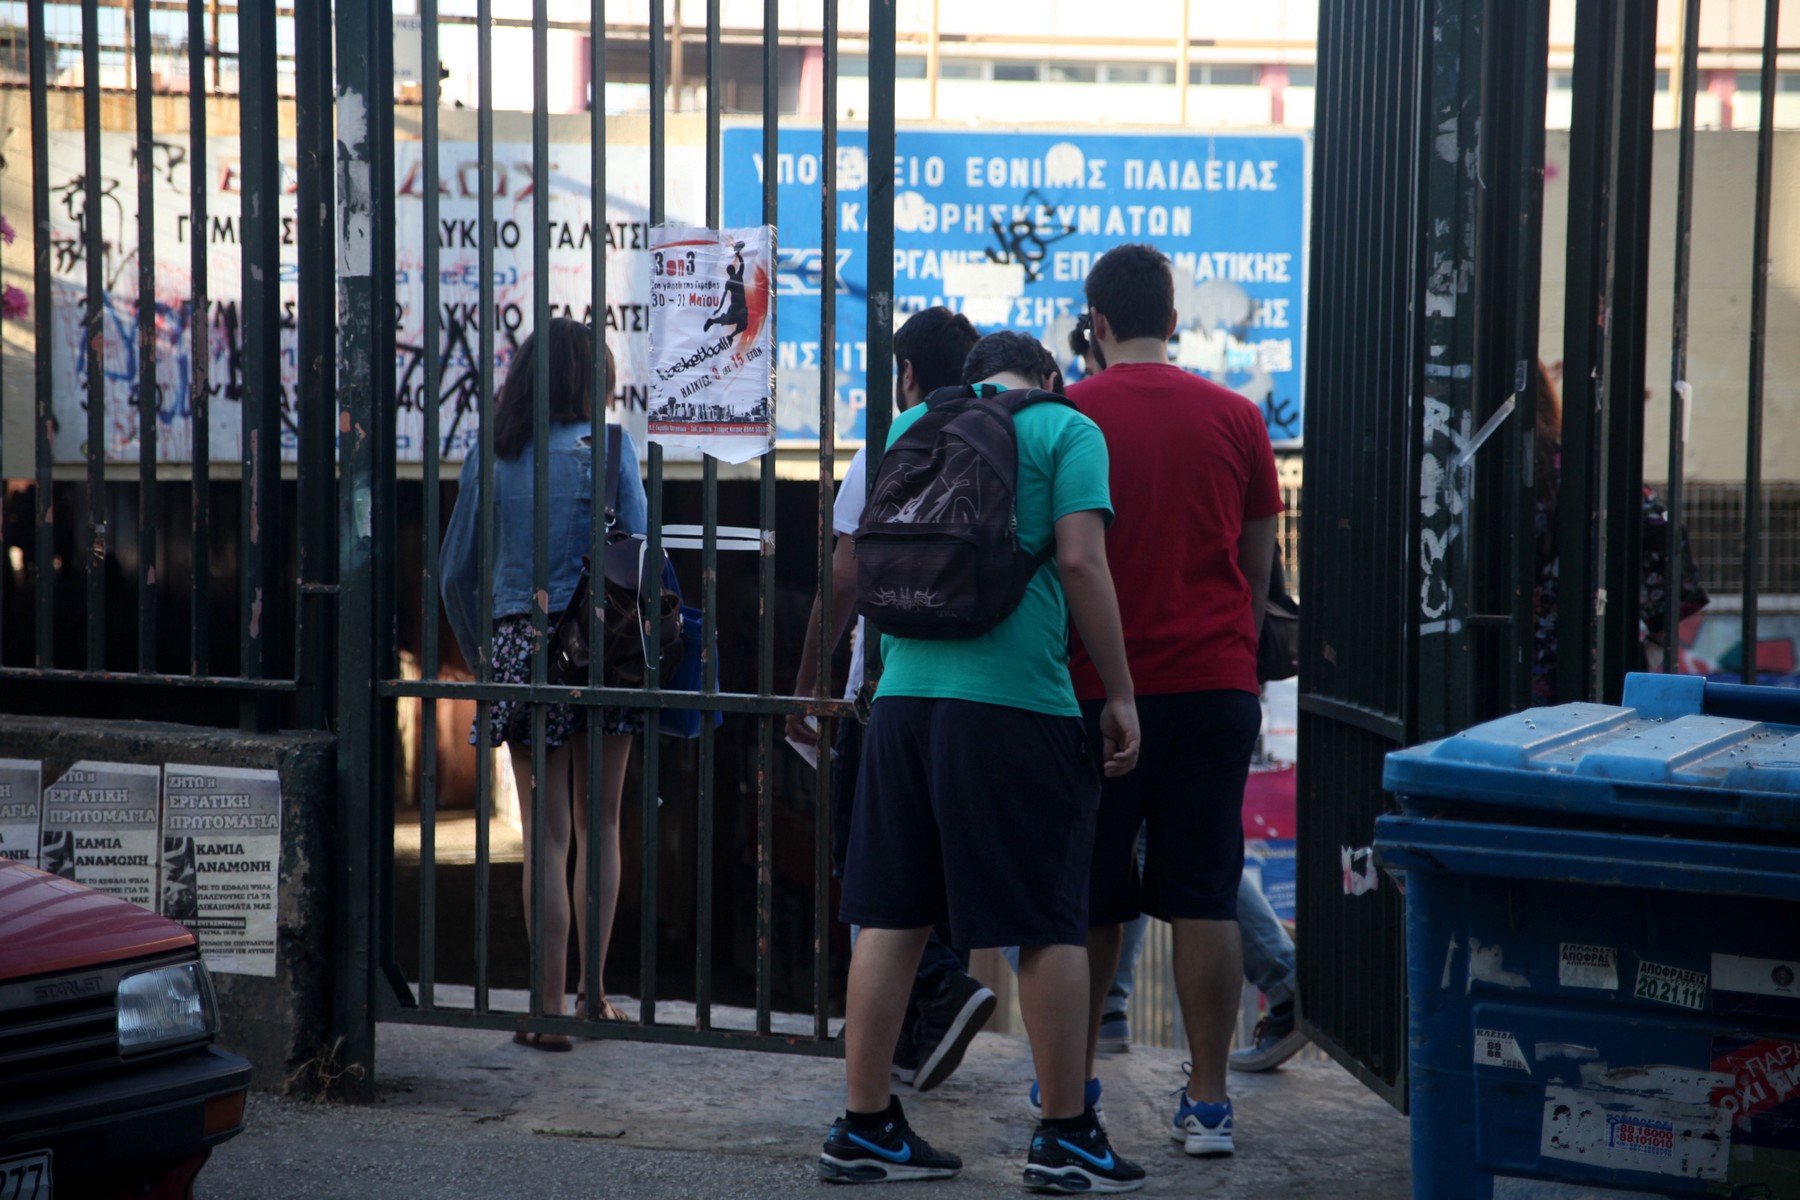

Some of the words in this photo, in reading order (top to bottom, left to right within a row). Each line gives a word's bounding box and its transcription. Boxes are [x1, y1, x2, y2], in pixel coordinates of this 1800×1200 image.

[1124, 159, 1279, 191] ΠΑΙΔΕΙΑΣ
[652, 293, 665, 307] 30
[168, 776, 204, 788] ΖΗΤΩ
[50, 788, 129, 803] ΕΡΓΑΤΙΚΗ
[169, 794, 250, 809] ΕΡΓΑΤΙΚΗ
[50, 809, 156, 824] ΠΡΩΤΟΜΑΓΙΑ
[169, 814, 279, 830] ΠΡΩΤΟΜΑΓΙΑ
[75, 838, 122, 849] ΚΑΜΙΑ
[196, 844, 245, 855] ΚΑΜΙΑ
[75, 855, 149, 867] ΑΝΑΜΟΝΗ
[197, 861, 271, 873] ΑΝΑΜΟΝΗ
[198, 903, 251, 911] ΔΙΚΑΙΩΜΑΤΑ
[1640, 962, 1706, 985] ΑΠΟΦΡΑΞΕΙΣ
[33, 976, 103, 1001] STARLET
[1636, 976, 1705, 1008] 20.21.111
